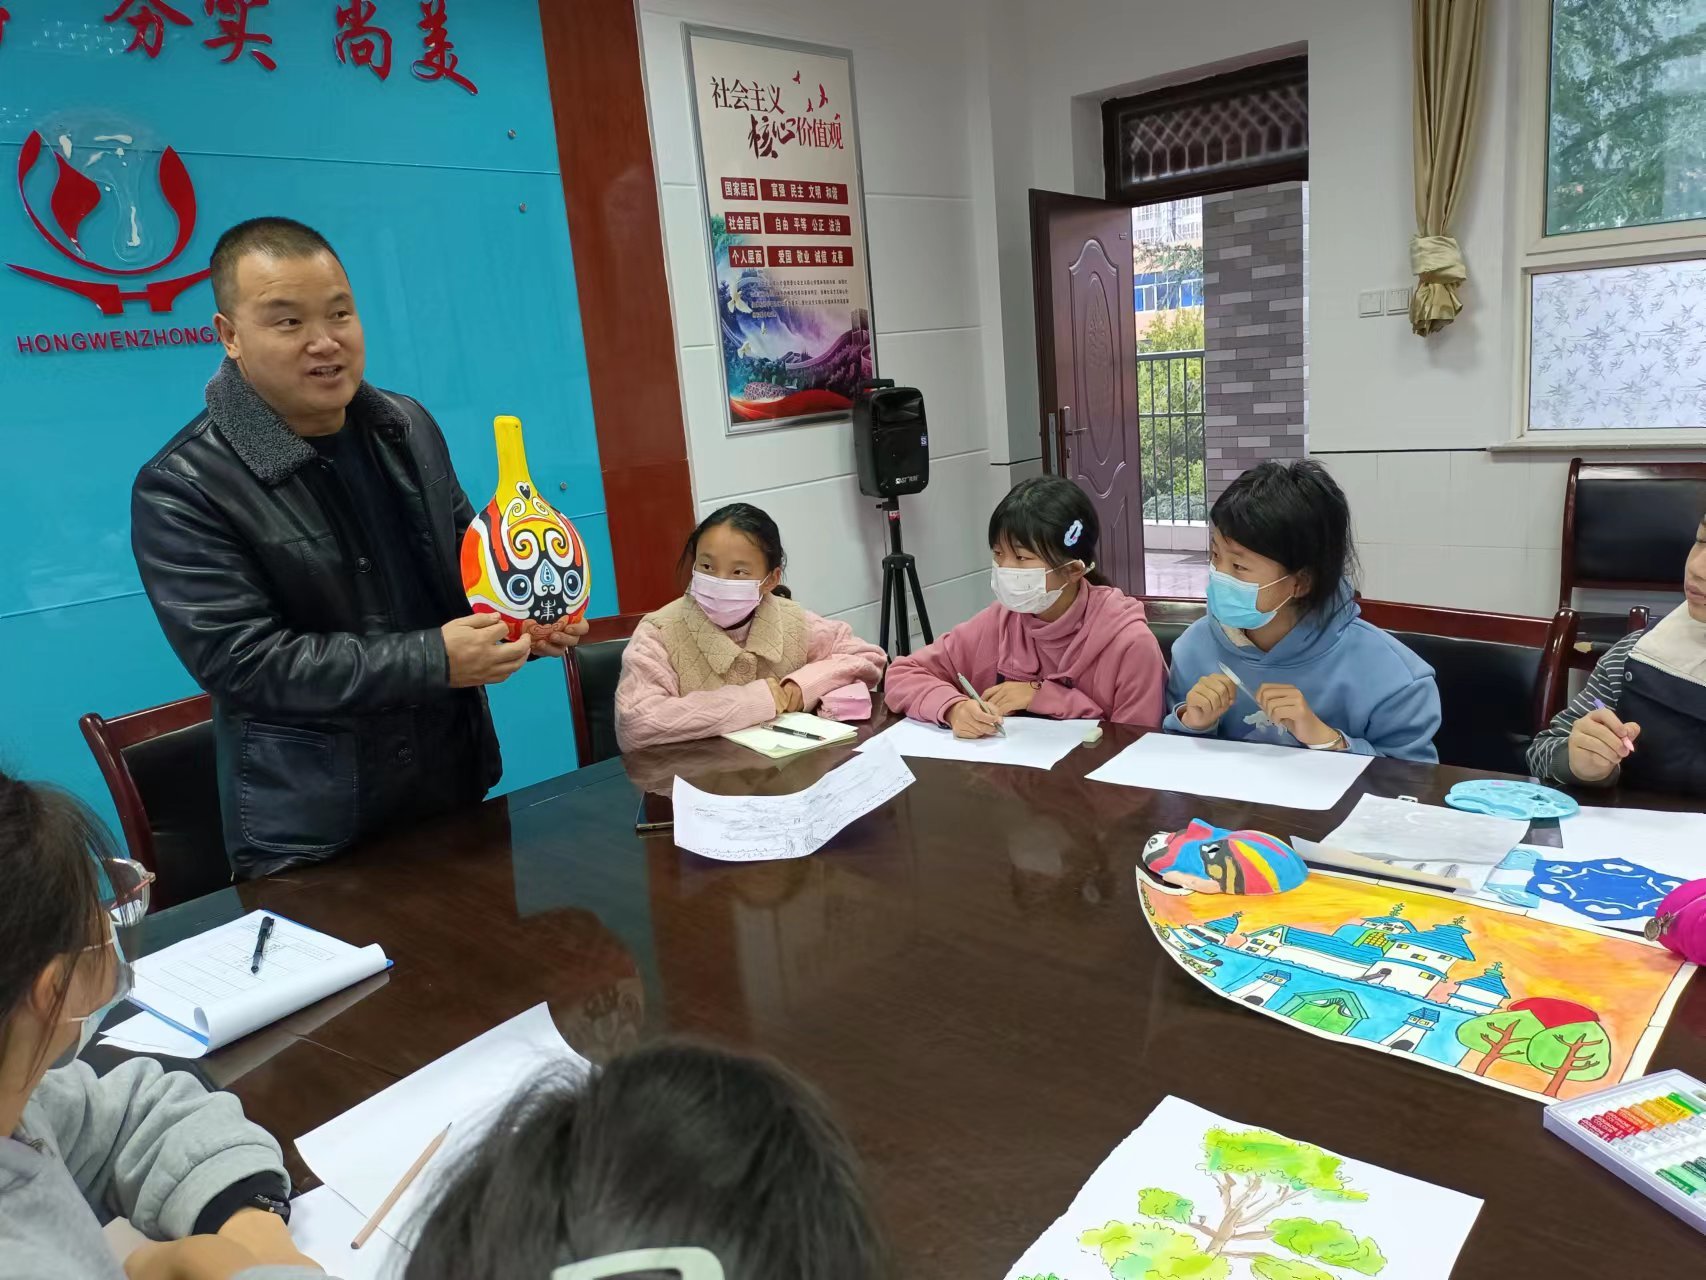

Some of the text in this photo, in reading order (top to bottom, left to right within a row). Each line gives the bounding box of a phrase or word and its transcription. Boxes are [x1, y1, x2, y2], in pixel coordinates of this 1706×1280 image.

[333, 0, 479, 95] 尚美
[711, 76, 784, 115] 社会主义
[748, 114, 843, 159] 核心价值观
[724, 181, 757, 197] 国家层面
[771, 183, 786, 198] 富强
[790, 184, 804, 198] 民主
[808, 185, 821, 199] 文明
[728, 216, 759, 231] 社会层面
[775, 217, 789, 231] 自由
[794, 217, 807, 231] 平等
[811, 218, 824, 231] 公正
[732, 249, 762, 264] 个人层面
[778, 250, 792, 264] 爱国
